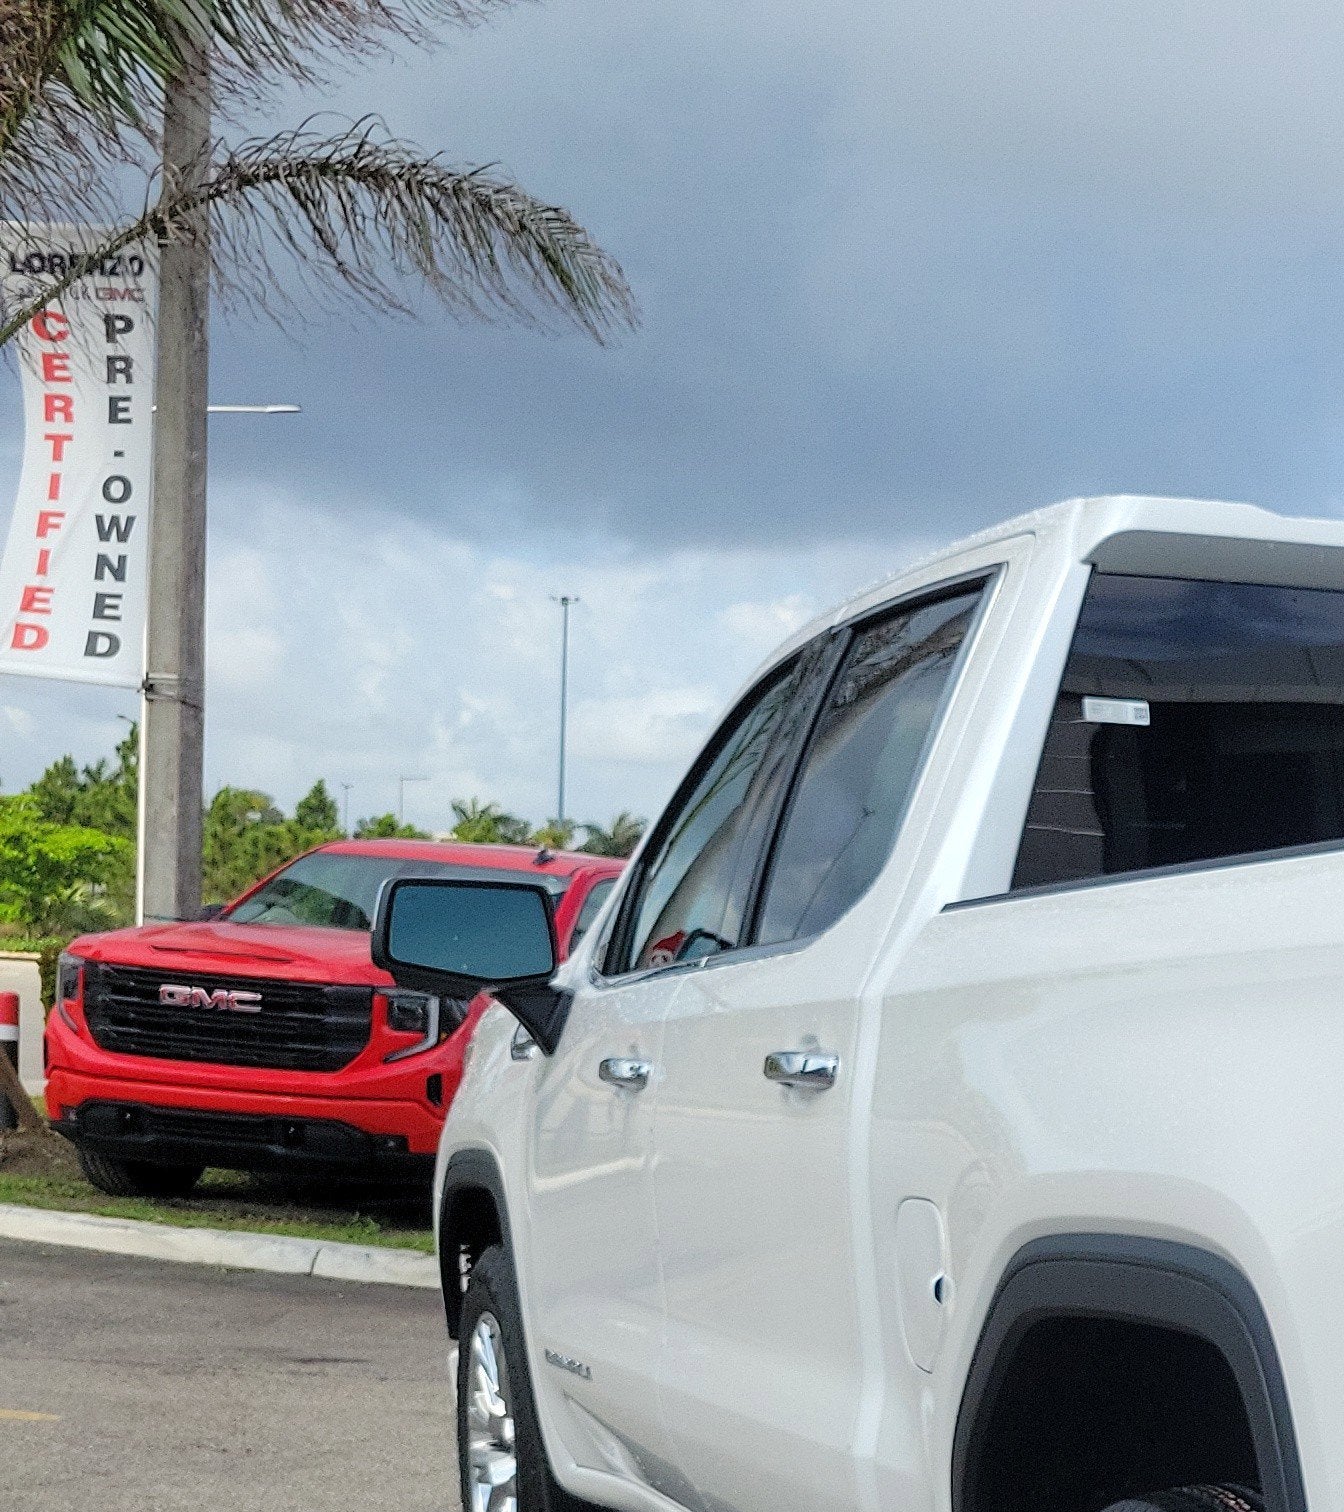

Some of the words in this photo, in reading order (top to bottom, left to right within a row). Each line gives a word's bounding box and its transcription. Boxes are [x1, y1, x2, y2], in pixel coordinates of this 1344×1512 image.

[10, 311, 74, 651] CERTIFIED
[84, 313, 136, 658] PRE-OWNED
[159, 984, 262, 1013] GMC
